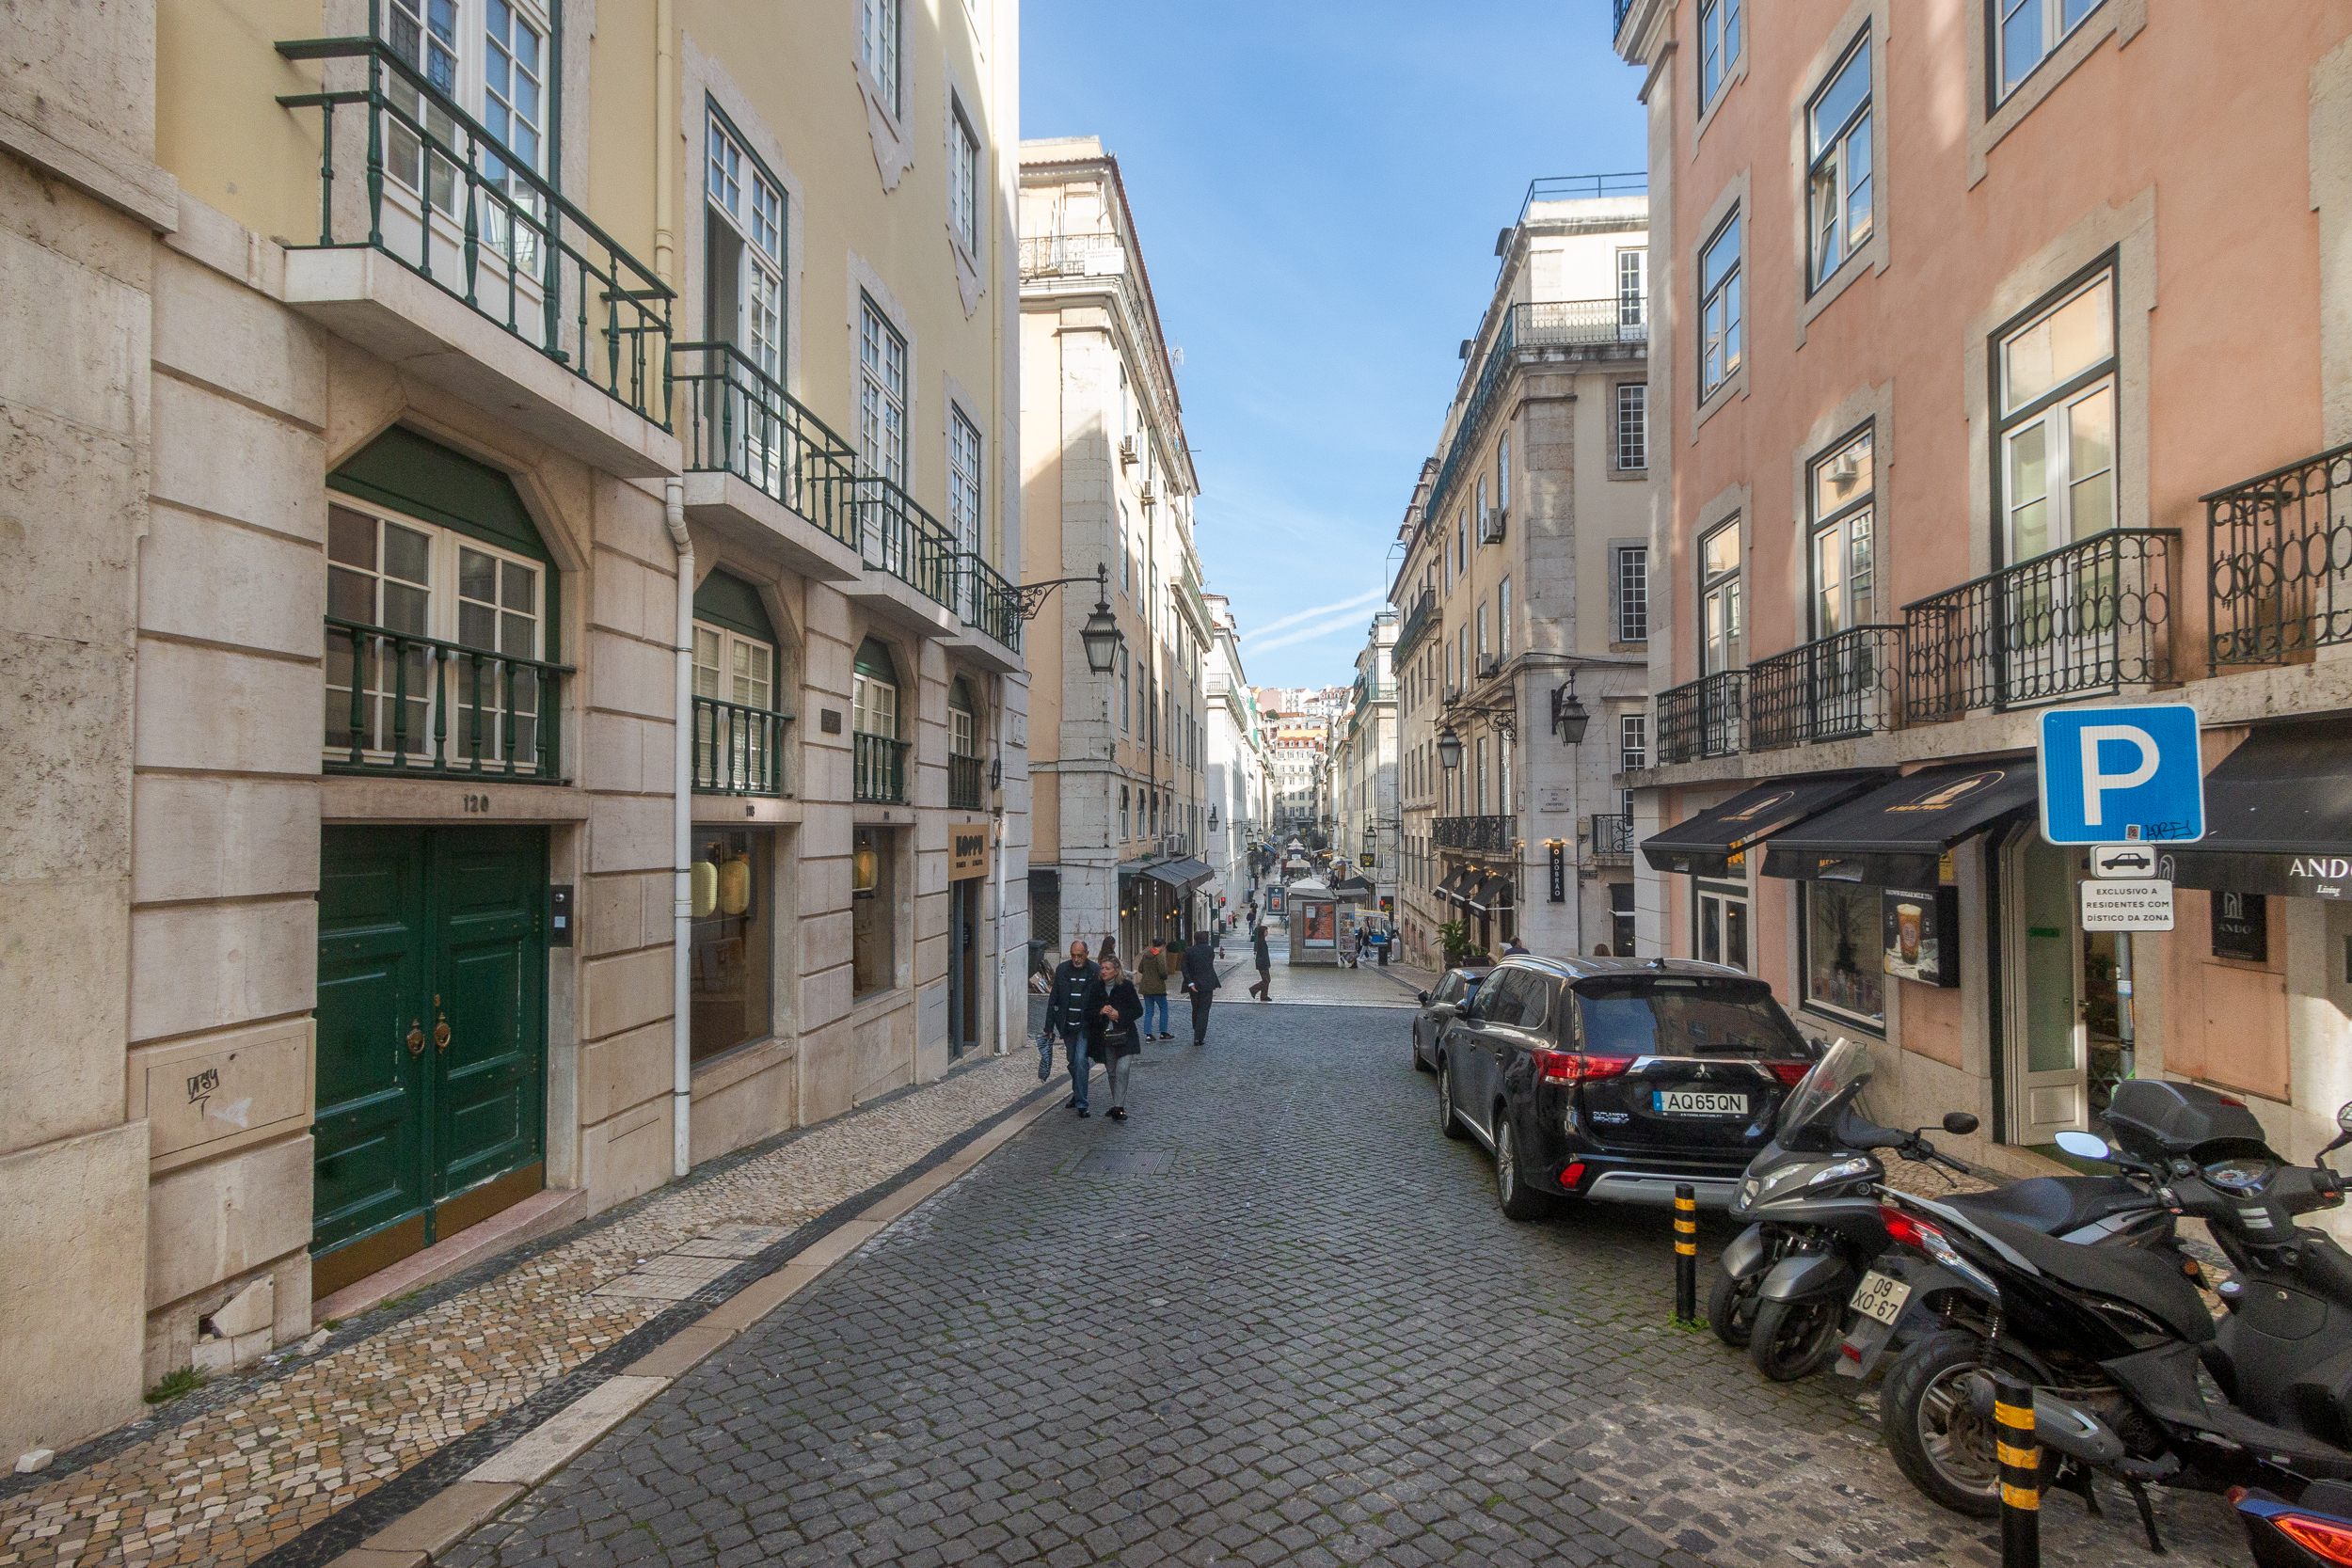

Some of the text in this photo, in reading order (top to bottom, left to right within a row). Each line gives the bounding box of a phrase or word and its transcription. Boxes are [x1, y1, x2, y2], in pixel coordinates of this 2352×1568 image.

[2079, 724, 2160, 826] P
[464, 794, 489, 812] 120
[2289, 858, 2352, 879] AND
[2087, 913, 2124, 922] DÍSTICO
[2219, 923, 2251, 935] ANDO
[1873, 1278, 1893, 1297] 09
